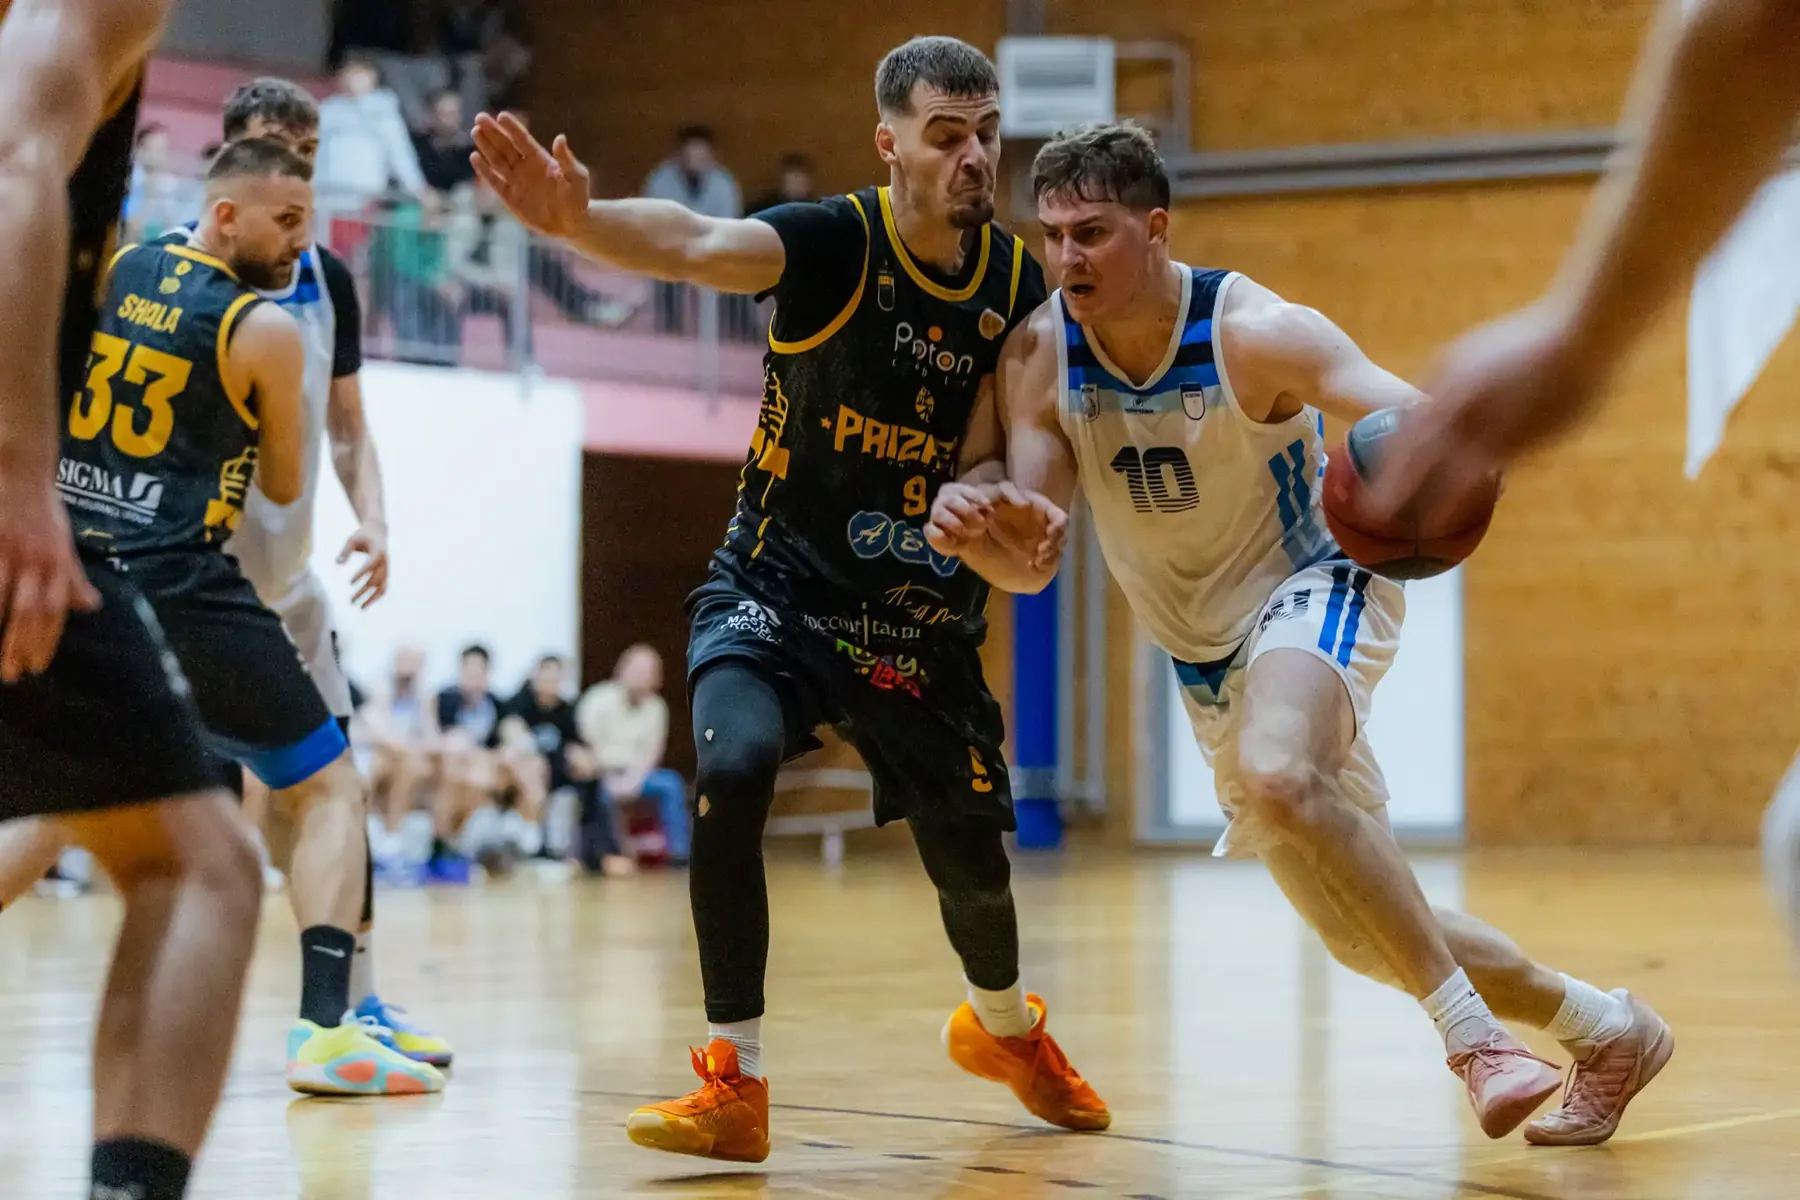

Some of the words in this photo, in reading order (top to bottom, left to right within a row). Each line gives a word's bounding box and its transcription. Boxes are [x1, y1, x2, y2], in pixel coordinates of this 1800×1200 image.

[117, 293, 184, 335] SHALA
[69, 330, 193, 458] 33
[57, 457, 123, 499] SIGMA
[903, 475, 927, 517] 9
[1109, 446, 1200, 513] 10
